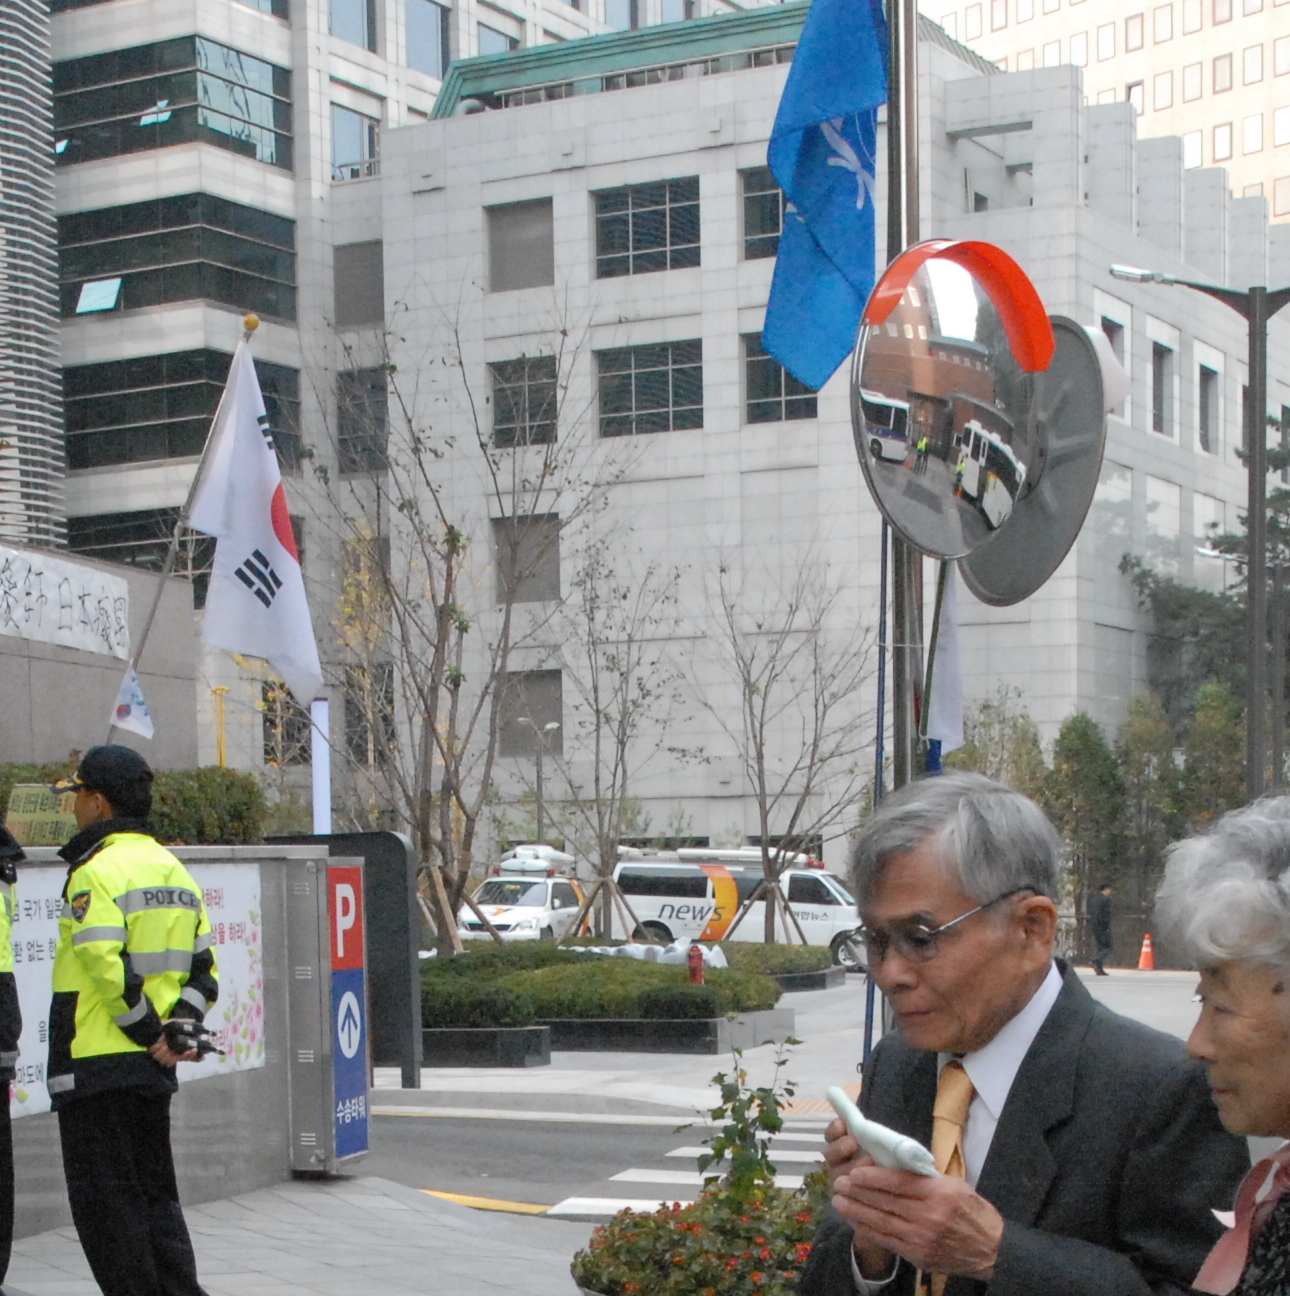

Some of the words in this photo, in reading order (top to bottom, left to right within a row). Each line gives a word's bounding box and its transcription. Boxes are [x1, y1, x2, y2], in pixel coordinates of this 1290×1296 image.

[23, 899, 42, 921] 국가
[335, 883, 357, 958] P
[658, 904, 726, 922] news
[26, 940, 45, 962] 없는
[336, 1094, 366, 1125] 수송타워
